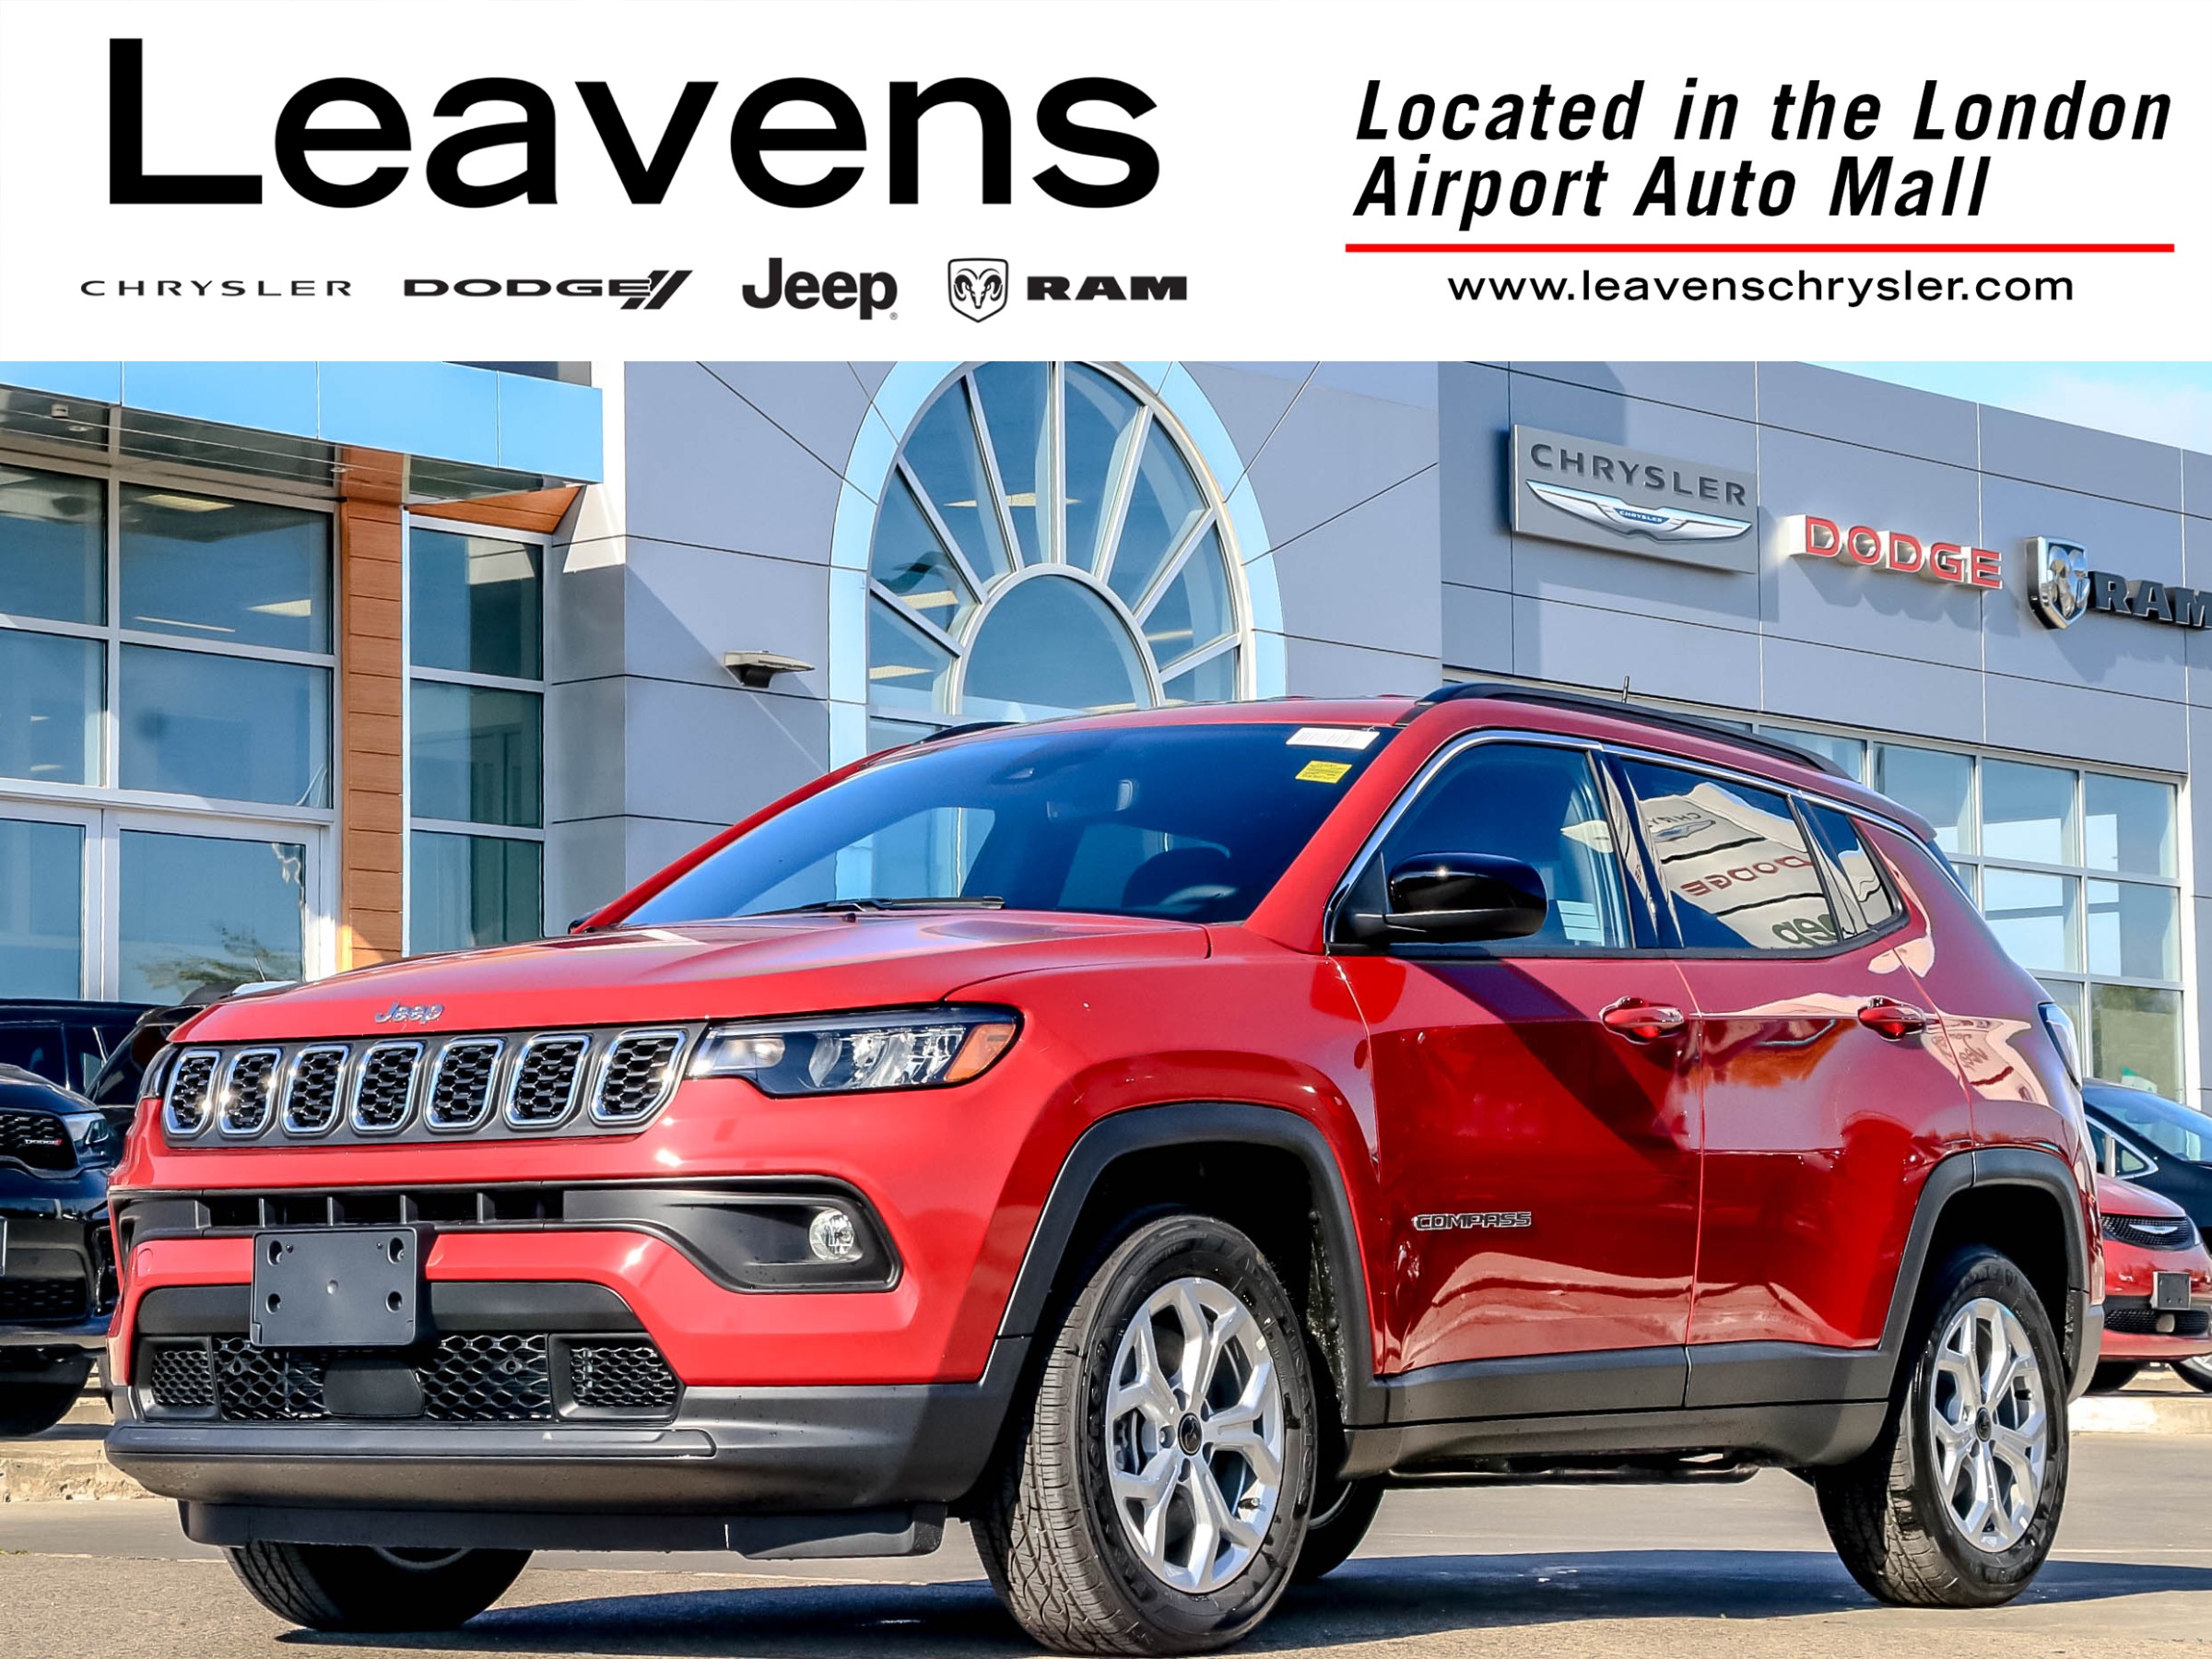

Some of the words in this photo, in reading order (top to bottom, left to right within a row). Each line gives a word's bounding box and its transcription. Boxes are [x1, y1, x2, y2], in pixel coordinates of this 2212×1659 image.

[1530, 443, 1747, 506] CHRYSLER
[1804, 513, 2004, 591] DODGE
[2090, 571, 2212, 629] RAM
[374, 1001, 444, 1026] Jeep
[1412, 1211, 1532, 1231] COMPASS
